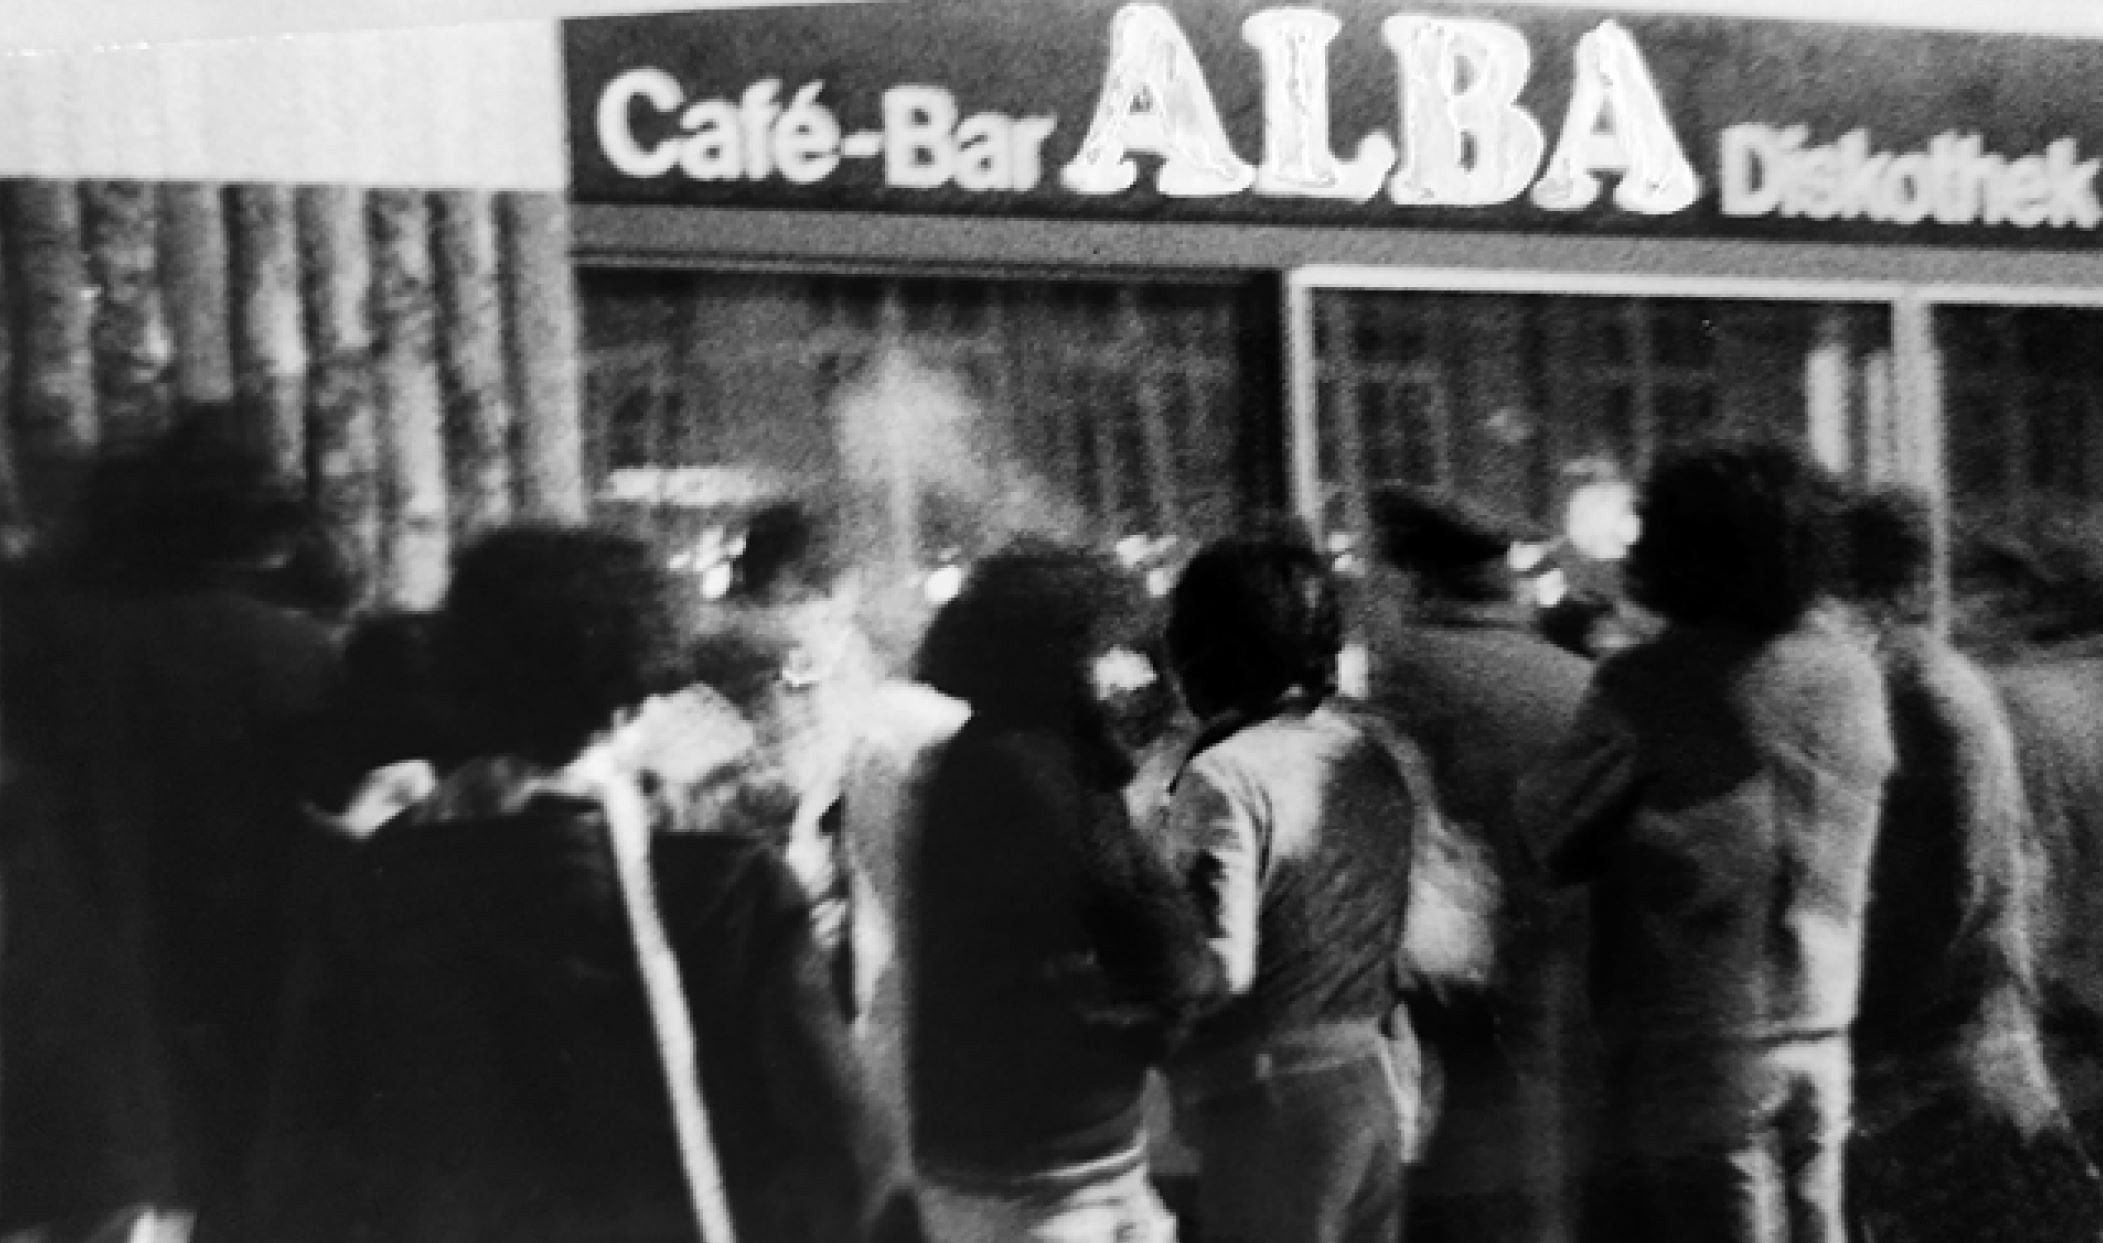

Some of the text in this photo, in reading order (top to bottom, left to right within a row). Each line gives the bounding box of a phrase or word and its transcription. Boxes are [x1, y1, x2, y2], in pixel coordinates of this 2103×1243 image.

[596, 2, 2102, 229] Café-Bar ALBA Diskothek
